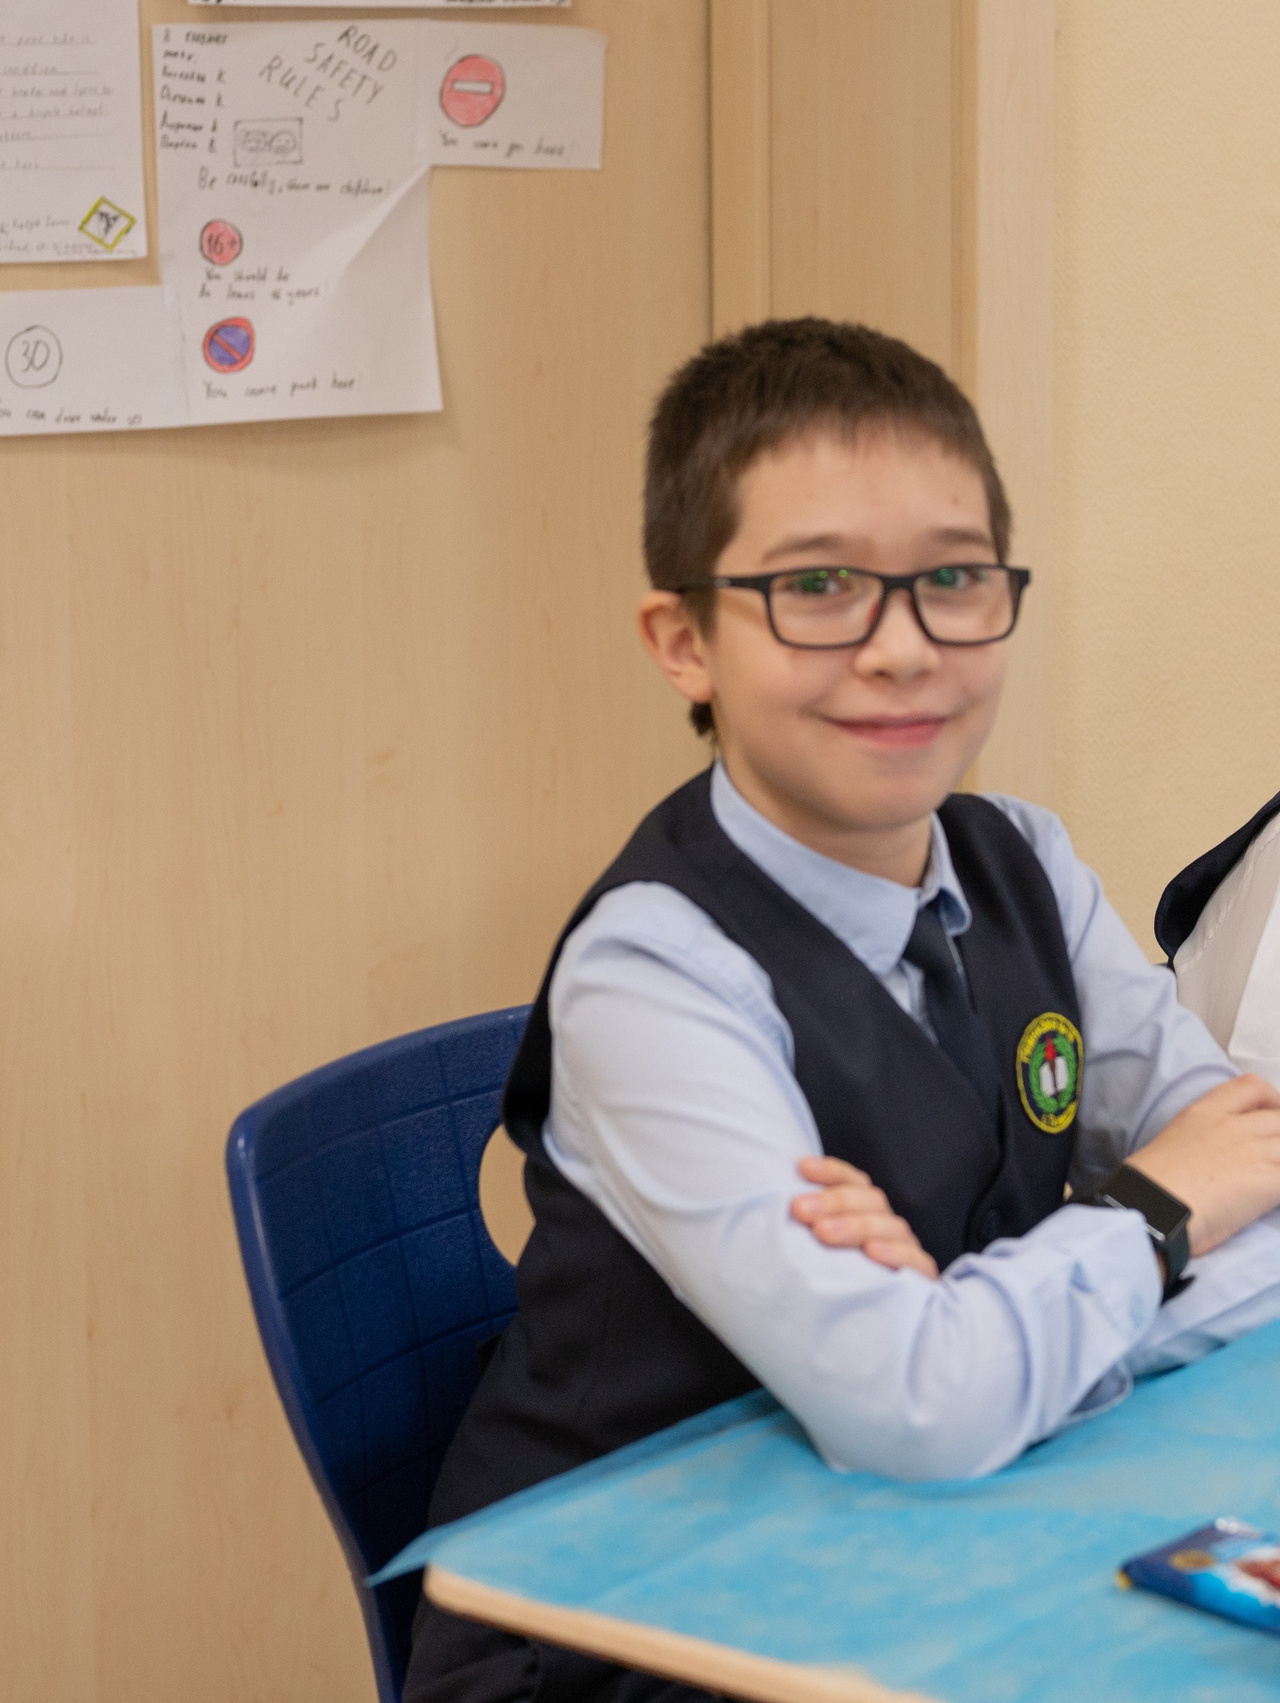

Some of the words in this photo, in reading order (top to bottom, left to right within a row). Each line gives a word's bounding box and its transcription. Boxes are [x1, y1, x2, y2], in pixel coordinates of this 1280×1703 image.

[304, 41, 385, 105] SAFETY
[337, 25, 398, 73] ROAD
[258, 55, 342, 123] RULES
[21, 339, 51, 373] 30
